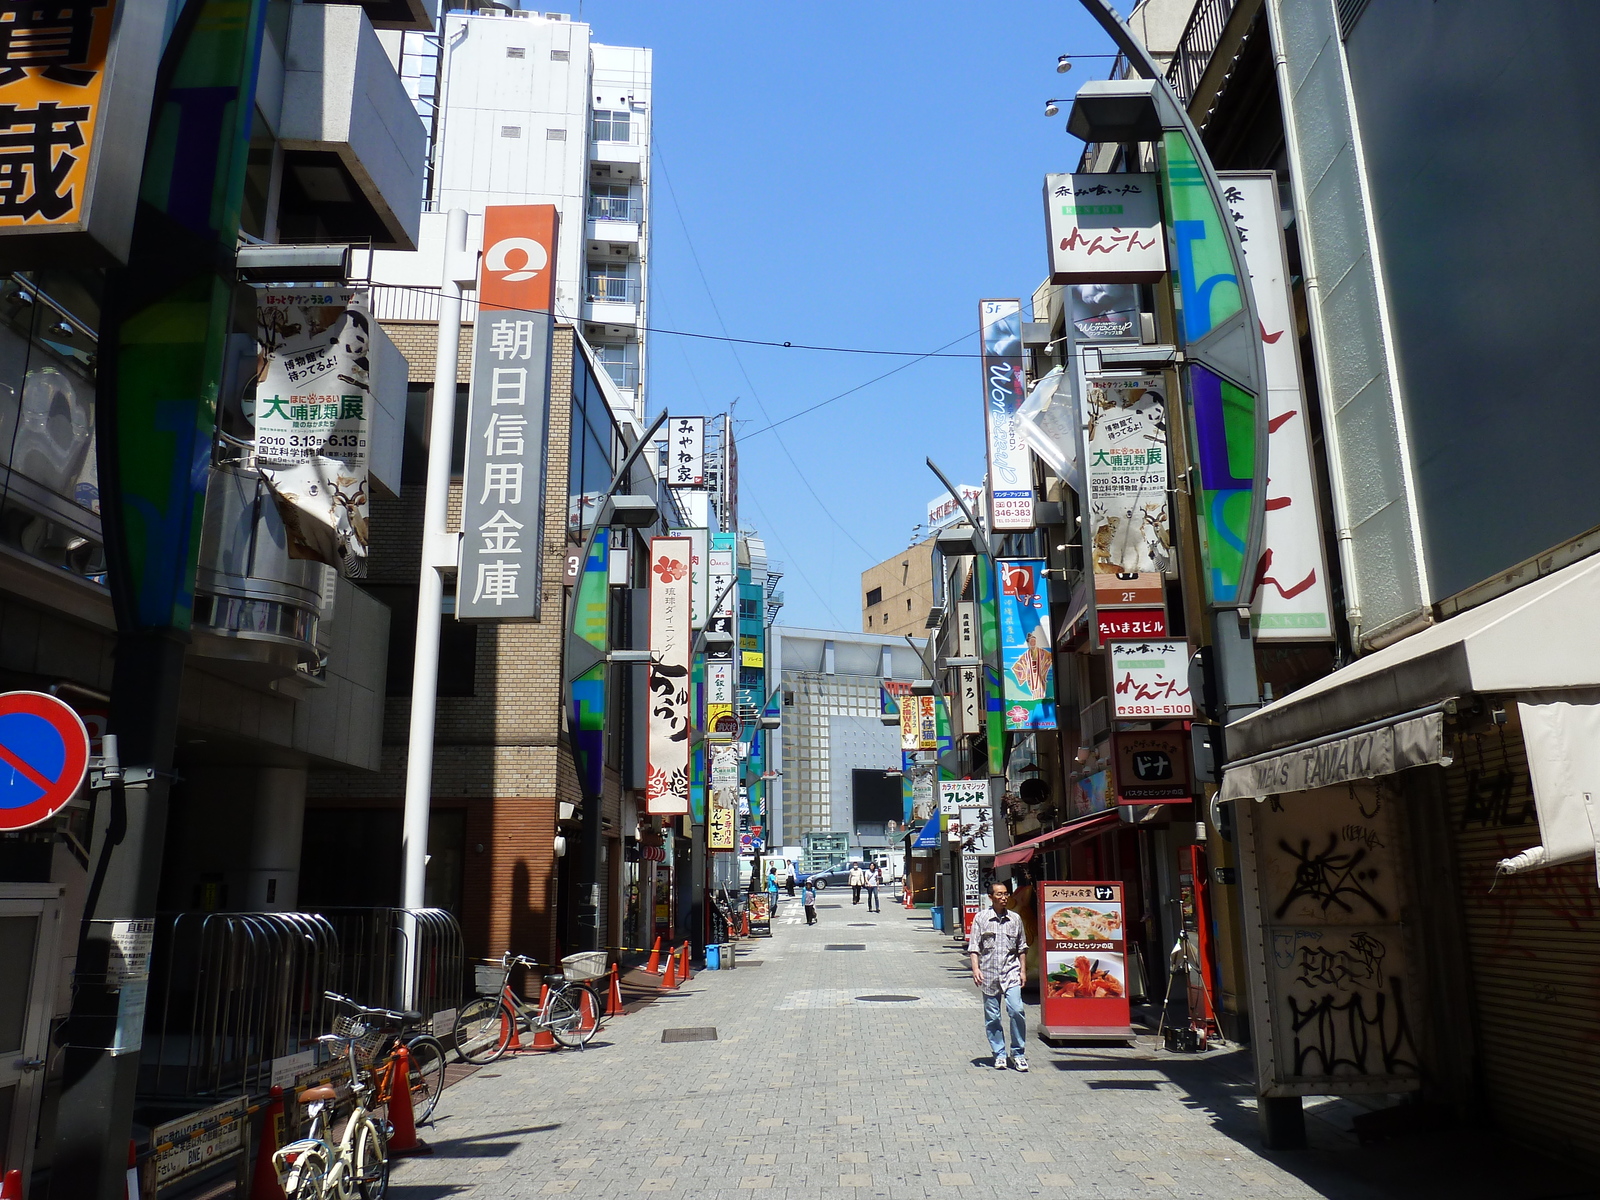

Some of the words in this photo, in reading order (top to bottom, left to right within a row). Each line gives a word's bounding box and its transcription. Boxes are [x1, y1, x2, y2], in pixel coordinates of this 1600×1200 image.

[1060, 227, 1155, 255] れんこん
[986, 303, 1002, 315] 5F
[284, 348, 325, 370] 博物館で
[260, 436, 285, 445] 2010
[290, 435, 316, 446] 3.13
[329, 435, 357, 447] 6.13
[259, 446, 325, 458] 国立科学博物館
[678, 420, 694, 482] みやね家
[471, 319, 533, 608] 朝日信用金庫
[1111, 476, 1130, 484] 3.13
[1140, 475, 1159, 483] 6.13
[1006, 500, 1030, 508] 0120
[995, 509, 1031, 517] 346-383
[1121, 592, 1137, 602] 2F
[665, 587, 676, 652] 琉球ダイニング
[1099, 619, 1164, 635] たいまるビル
[1116, 672, 1189, 701] れんこん
[1127, 704, 1190, 716] 3831-5100
[1136, 755, 1169, 777] ドナ
[944, 792, 984, 803] フレンド
[1096, 887, 1112, 899] ドナ
